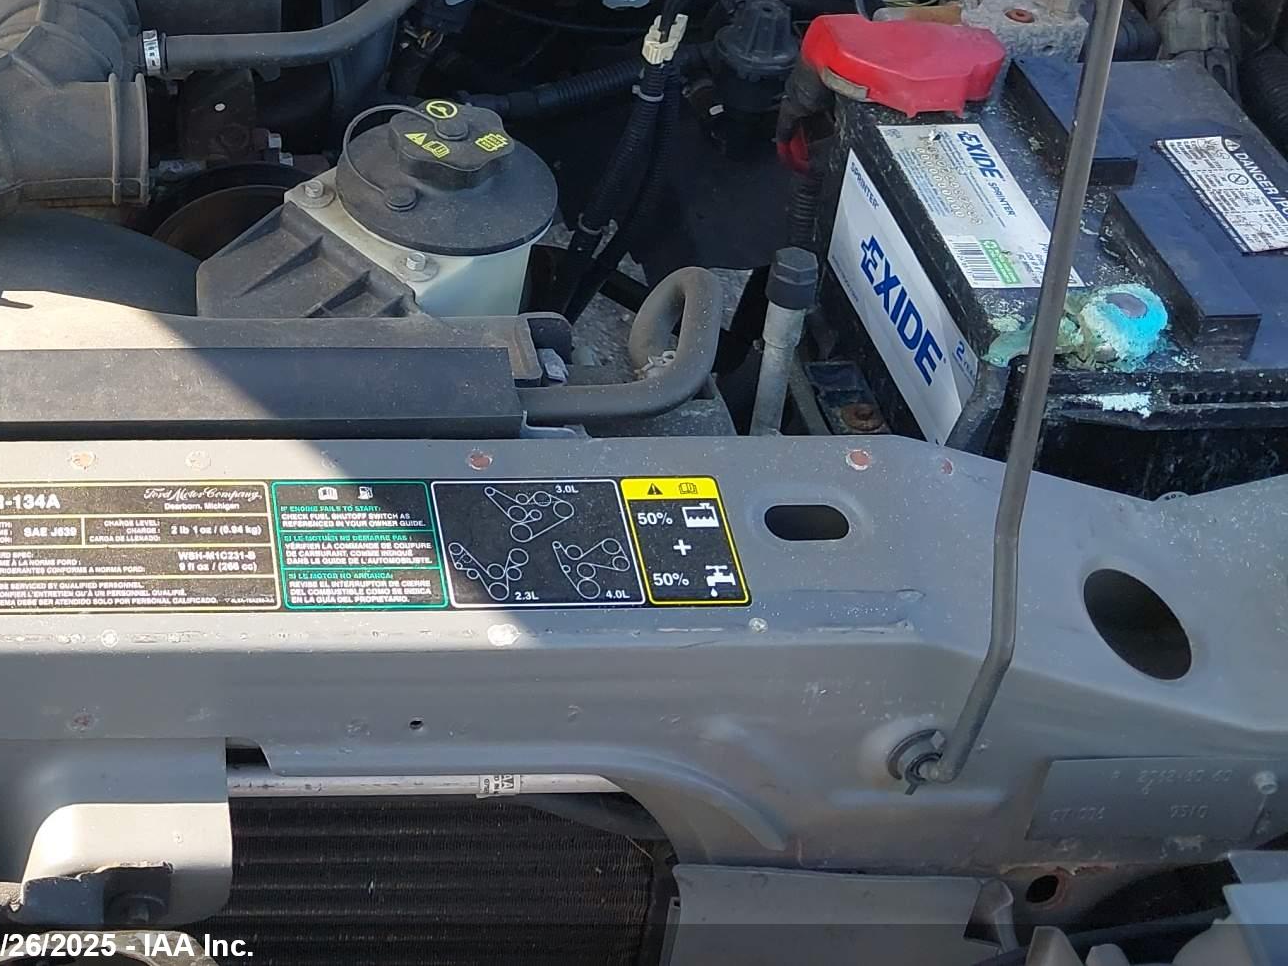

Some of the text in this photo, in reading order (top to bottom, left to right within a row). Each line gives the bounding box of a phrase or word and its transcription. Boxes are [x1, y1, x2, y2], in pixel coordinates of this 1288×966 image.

[957, 131, 1003, 178] EXIDE
[1234, 153, 1279, 194] DANGER
[861, 234, 943, 387] EXIDE
[555, 485, 579, 493] 3.0L
[164, 502, 239, 510] Dearborn, Michigan
[637, 512, 673, 525] 50%
[24, 527, 47, 537] SAE
[171, 526, 177, 534] 2
[179, 526, 189, 534] lb
[245, 525, 262, 535] kg)
[653, 573, 689, 586] 50%
[515, 591, 538, 600] 2.3L
[606, 590, 630, 599] 4.0L
